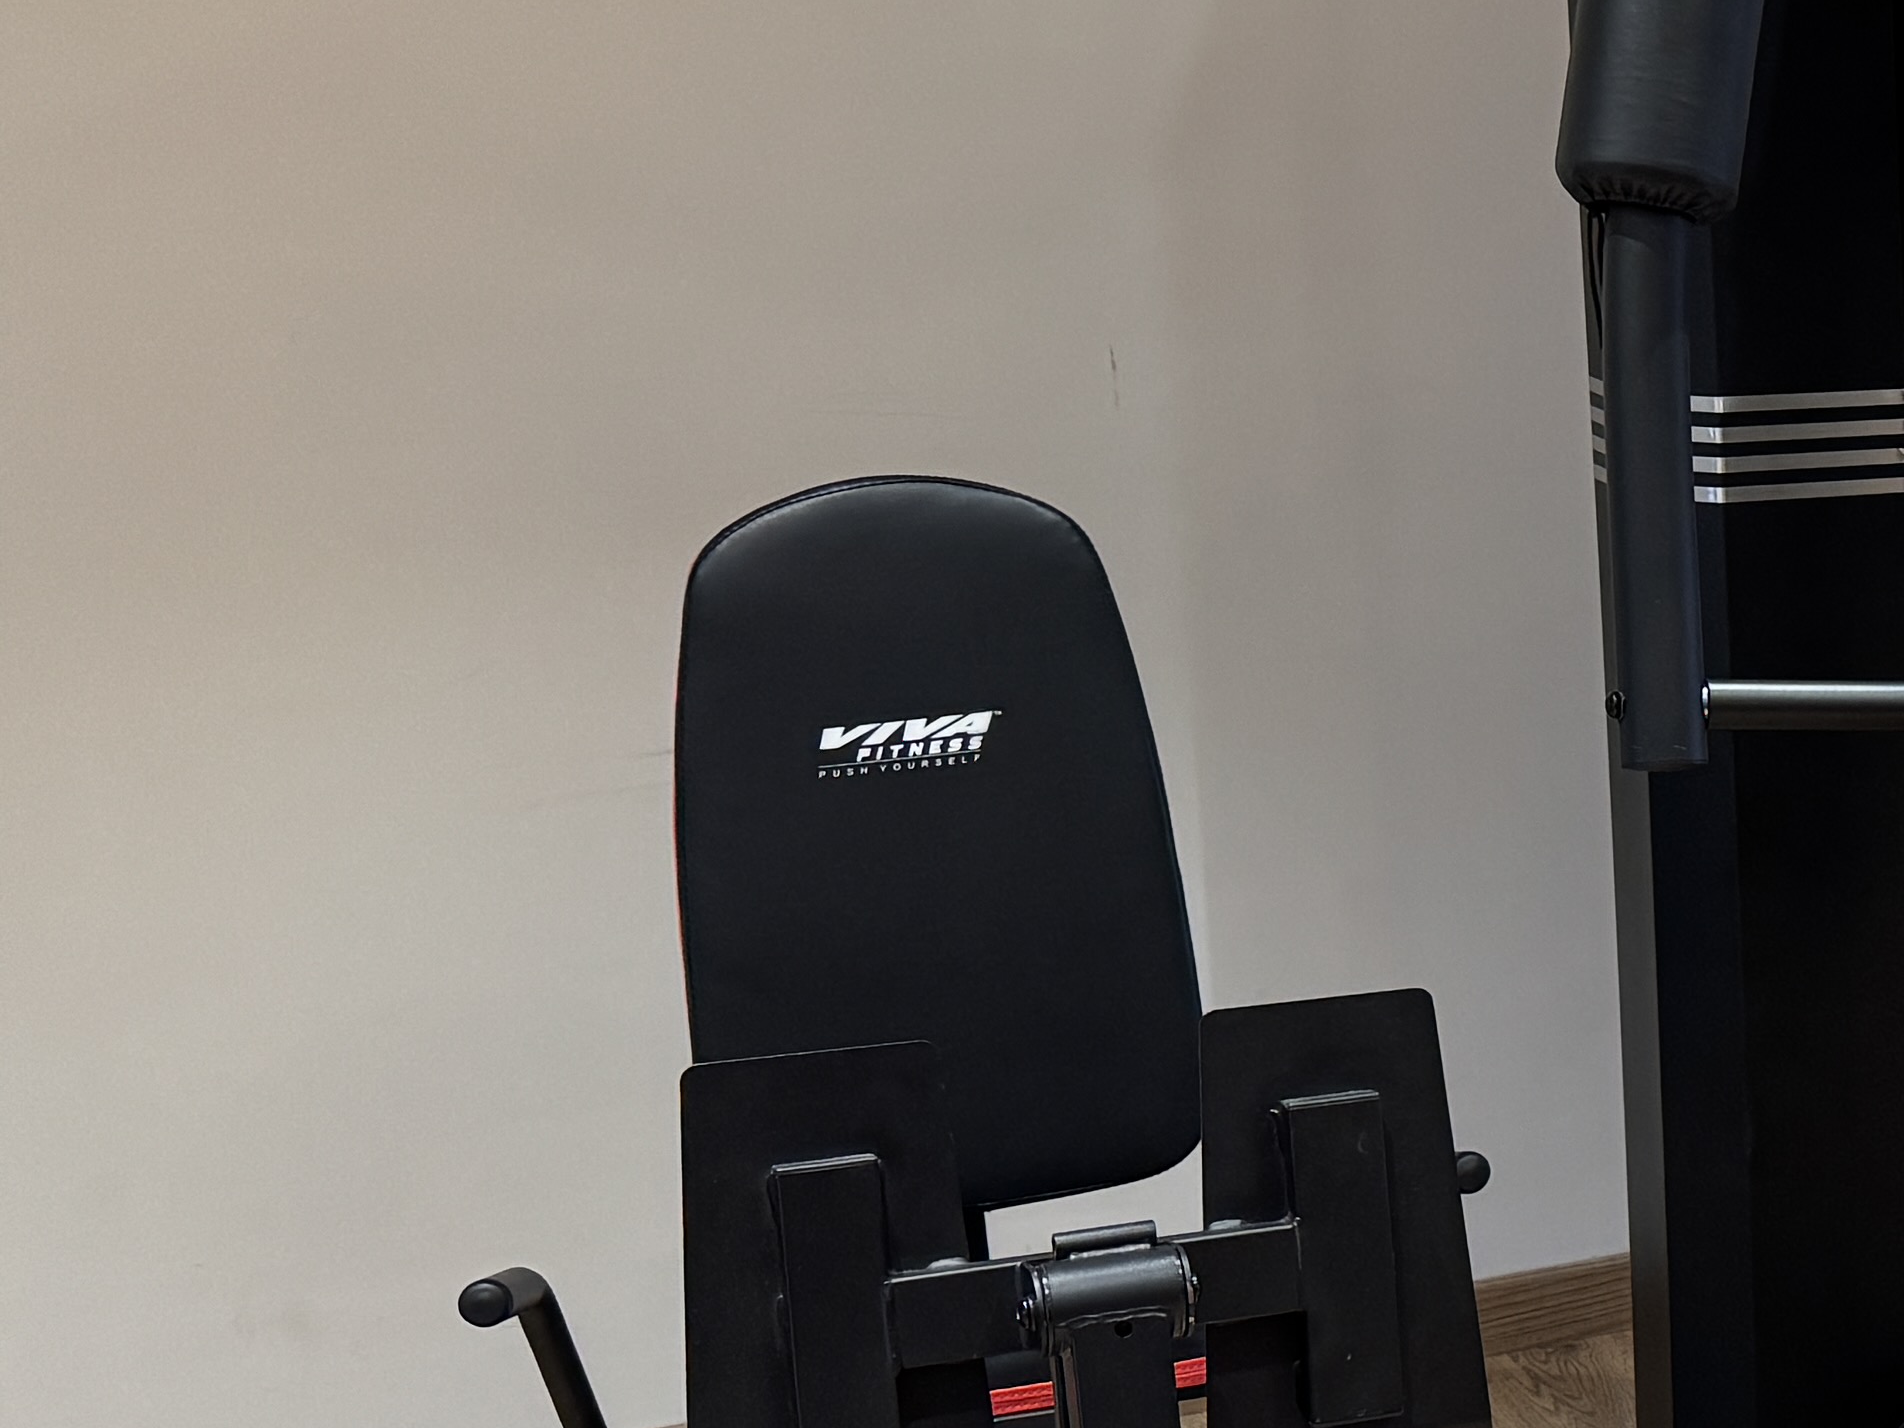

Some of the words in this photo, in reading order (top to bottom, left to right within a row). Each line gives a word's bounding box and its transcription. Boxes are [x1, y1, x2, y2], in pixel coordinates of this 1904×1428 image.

[818, 710, 993, 751] VIVA
[855, 735, 984, 763] FITNESS
[817, 765, 869, 780] PUSH
[879, 753, 982, 774] YOURSELF
